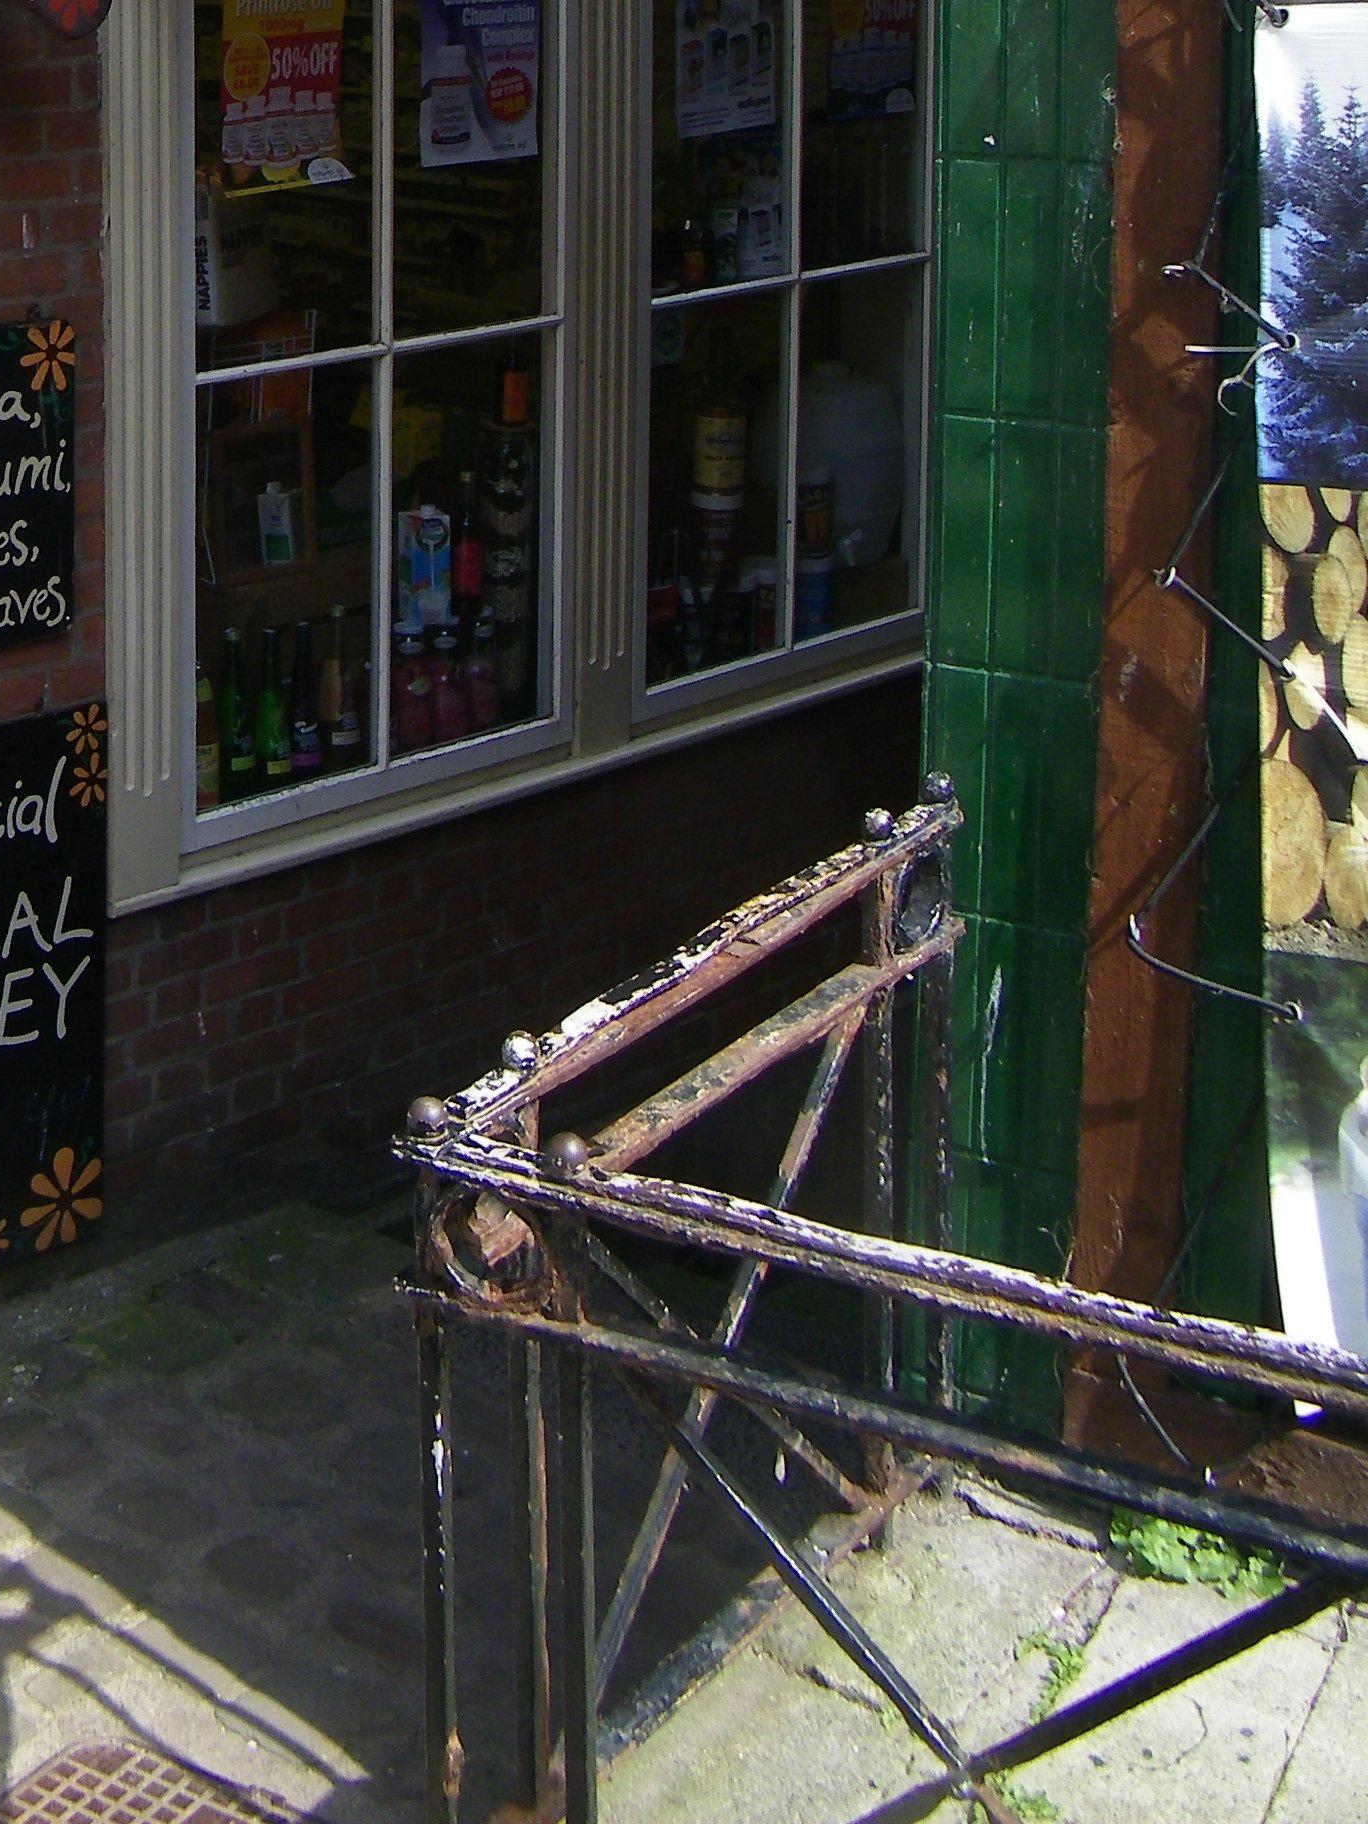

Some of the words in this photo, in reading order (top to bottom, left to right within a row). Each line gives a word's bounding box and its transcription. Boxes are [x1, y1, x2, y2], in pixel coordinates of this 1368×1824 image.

[462, 5, 536, 27] Chondroitin
[482, 28, 535, 49] Complex
[195, 235, 211, 310] NAPPIES
